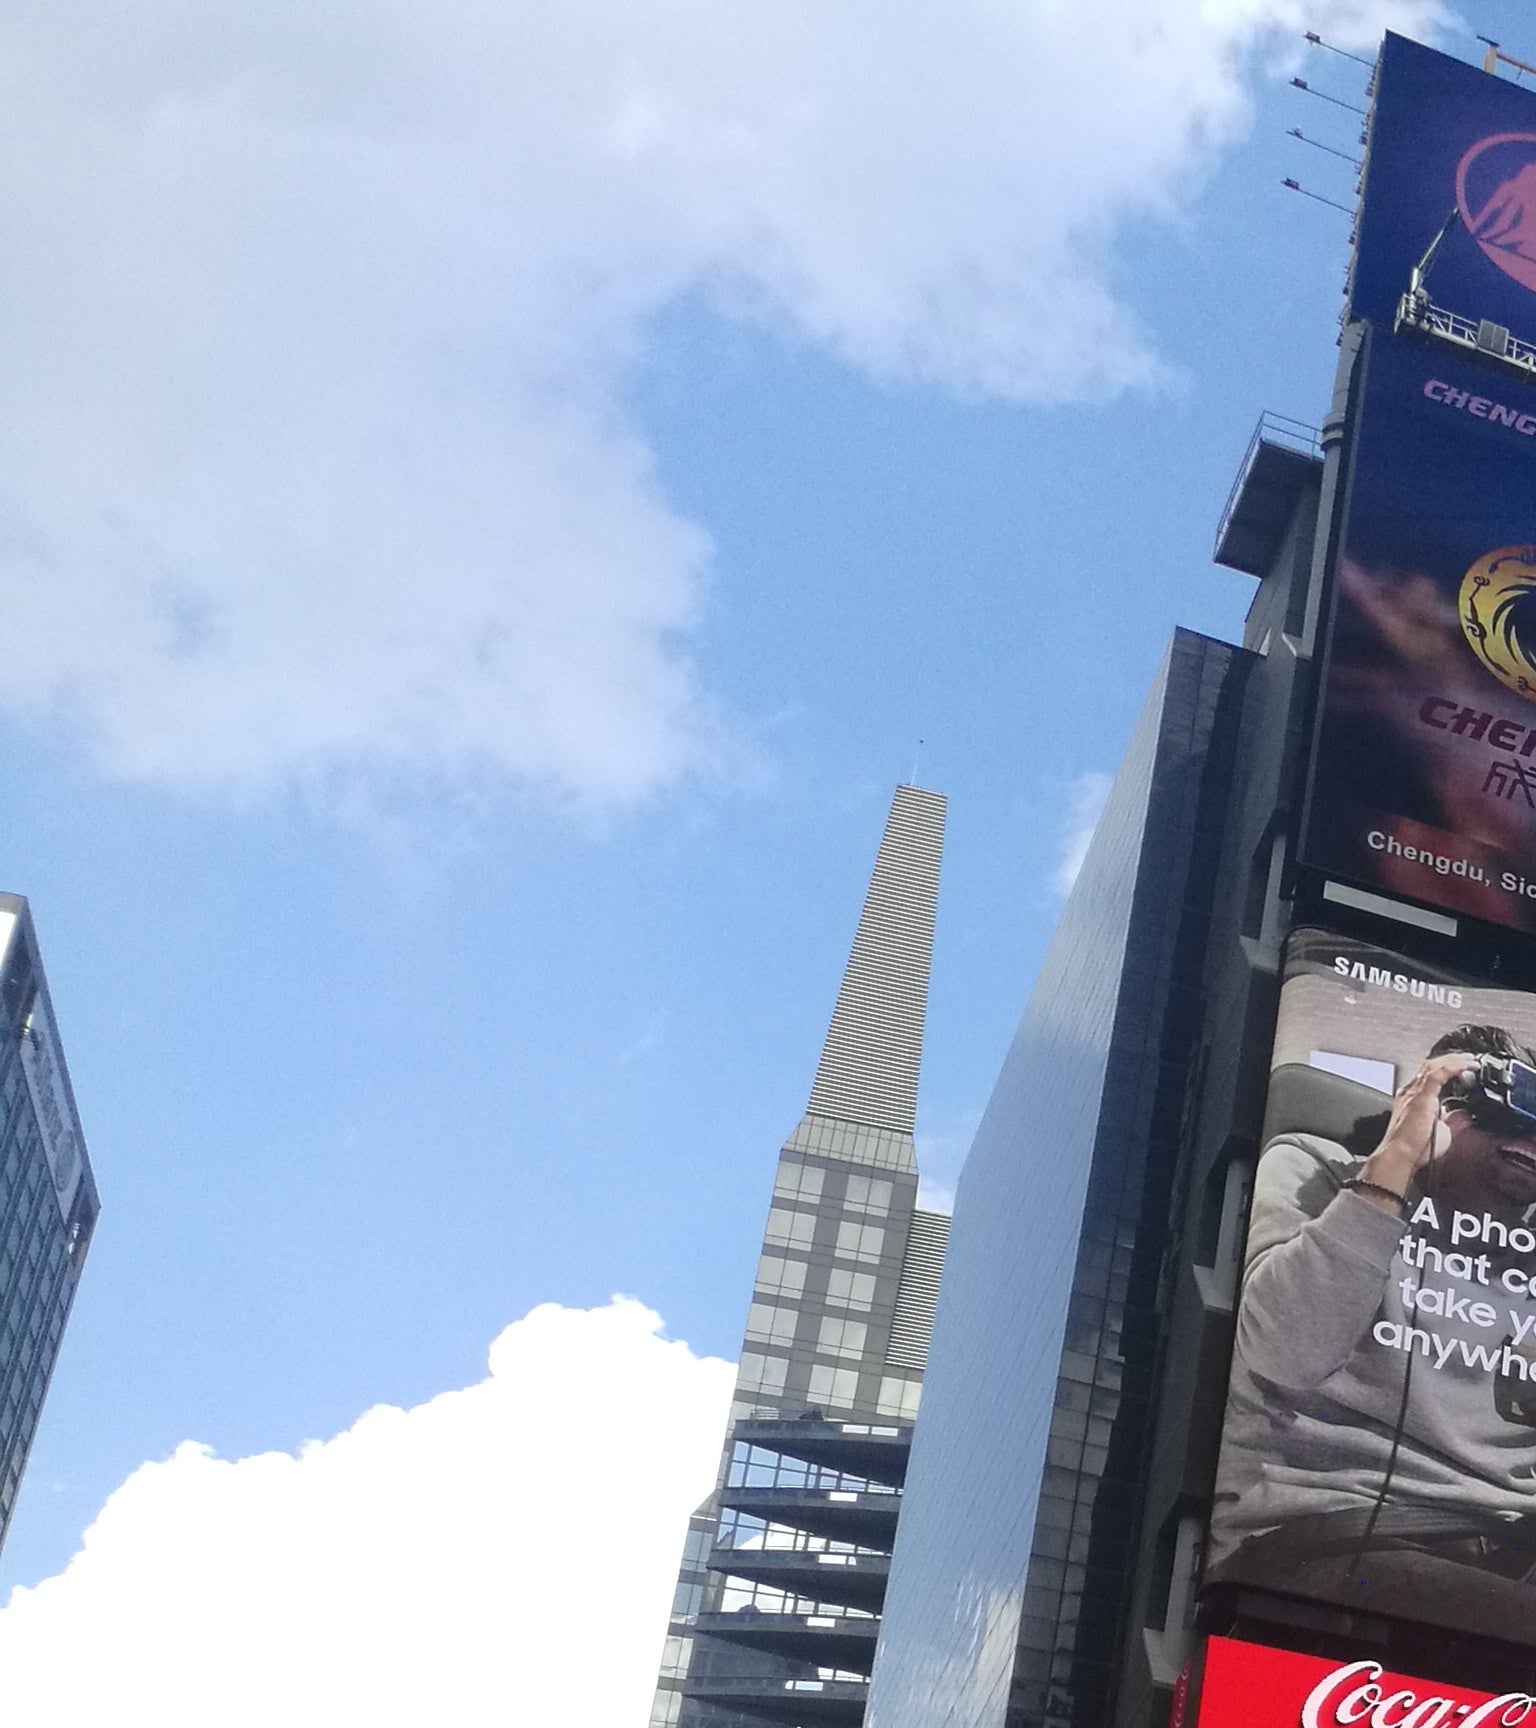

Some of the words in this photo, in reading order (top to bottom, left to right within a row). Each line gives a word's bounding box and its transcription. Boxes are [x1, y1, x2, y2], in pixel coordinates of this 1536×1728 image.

[1367, 830, 1493, 889] Chengdu,
[1334, 956, 1462, 1010] SAMSUNG
[1409, 1197, 1440, 1230] A
[1400, 1232, 1491, 1288] that
[1399, 1278, 1496, 1329] take
